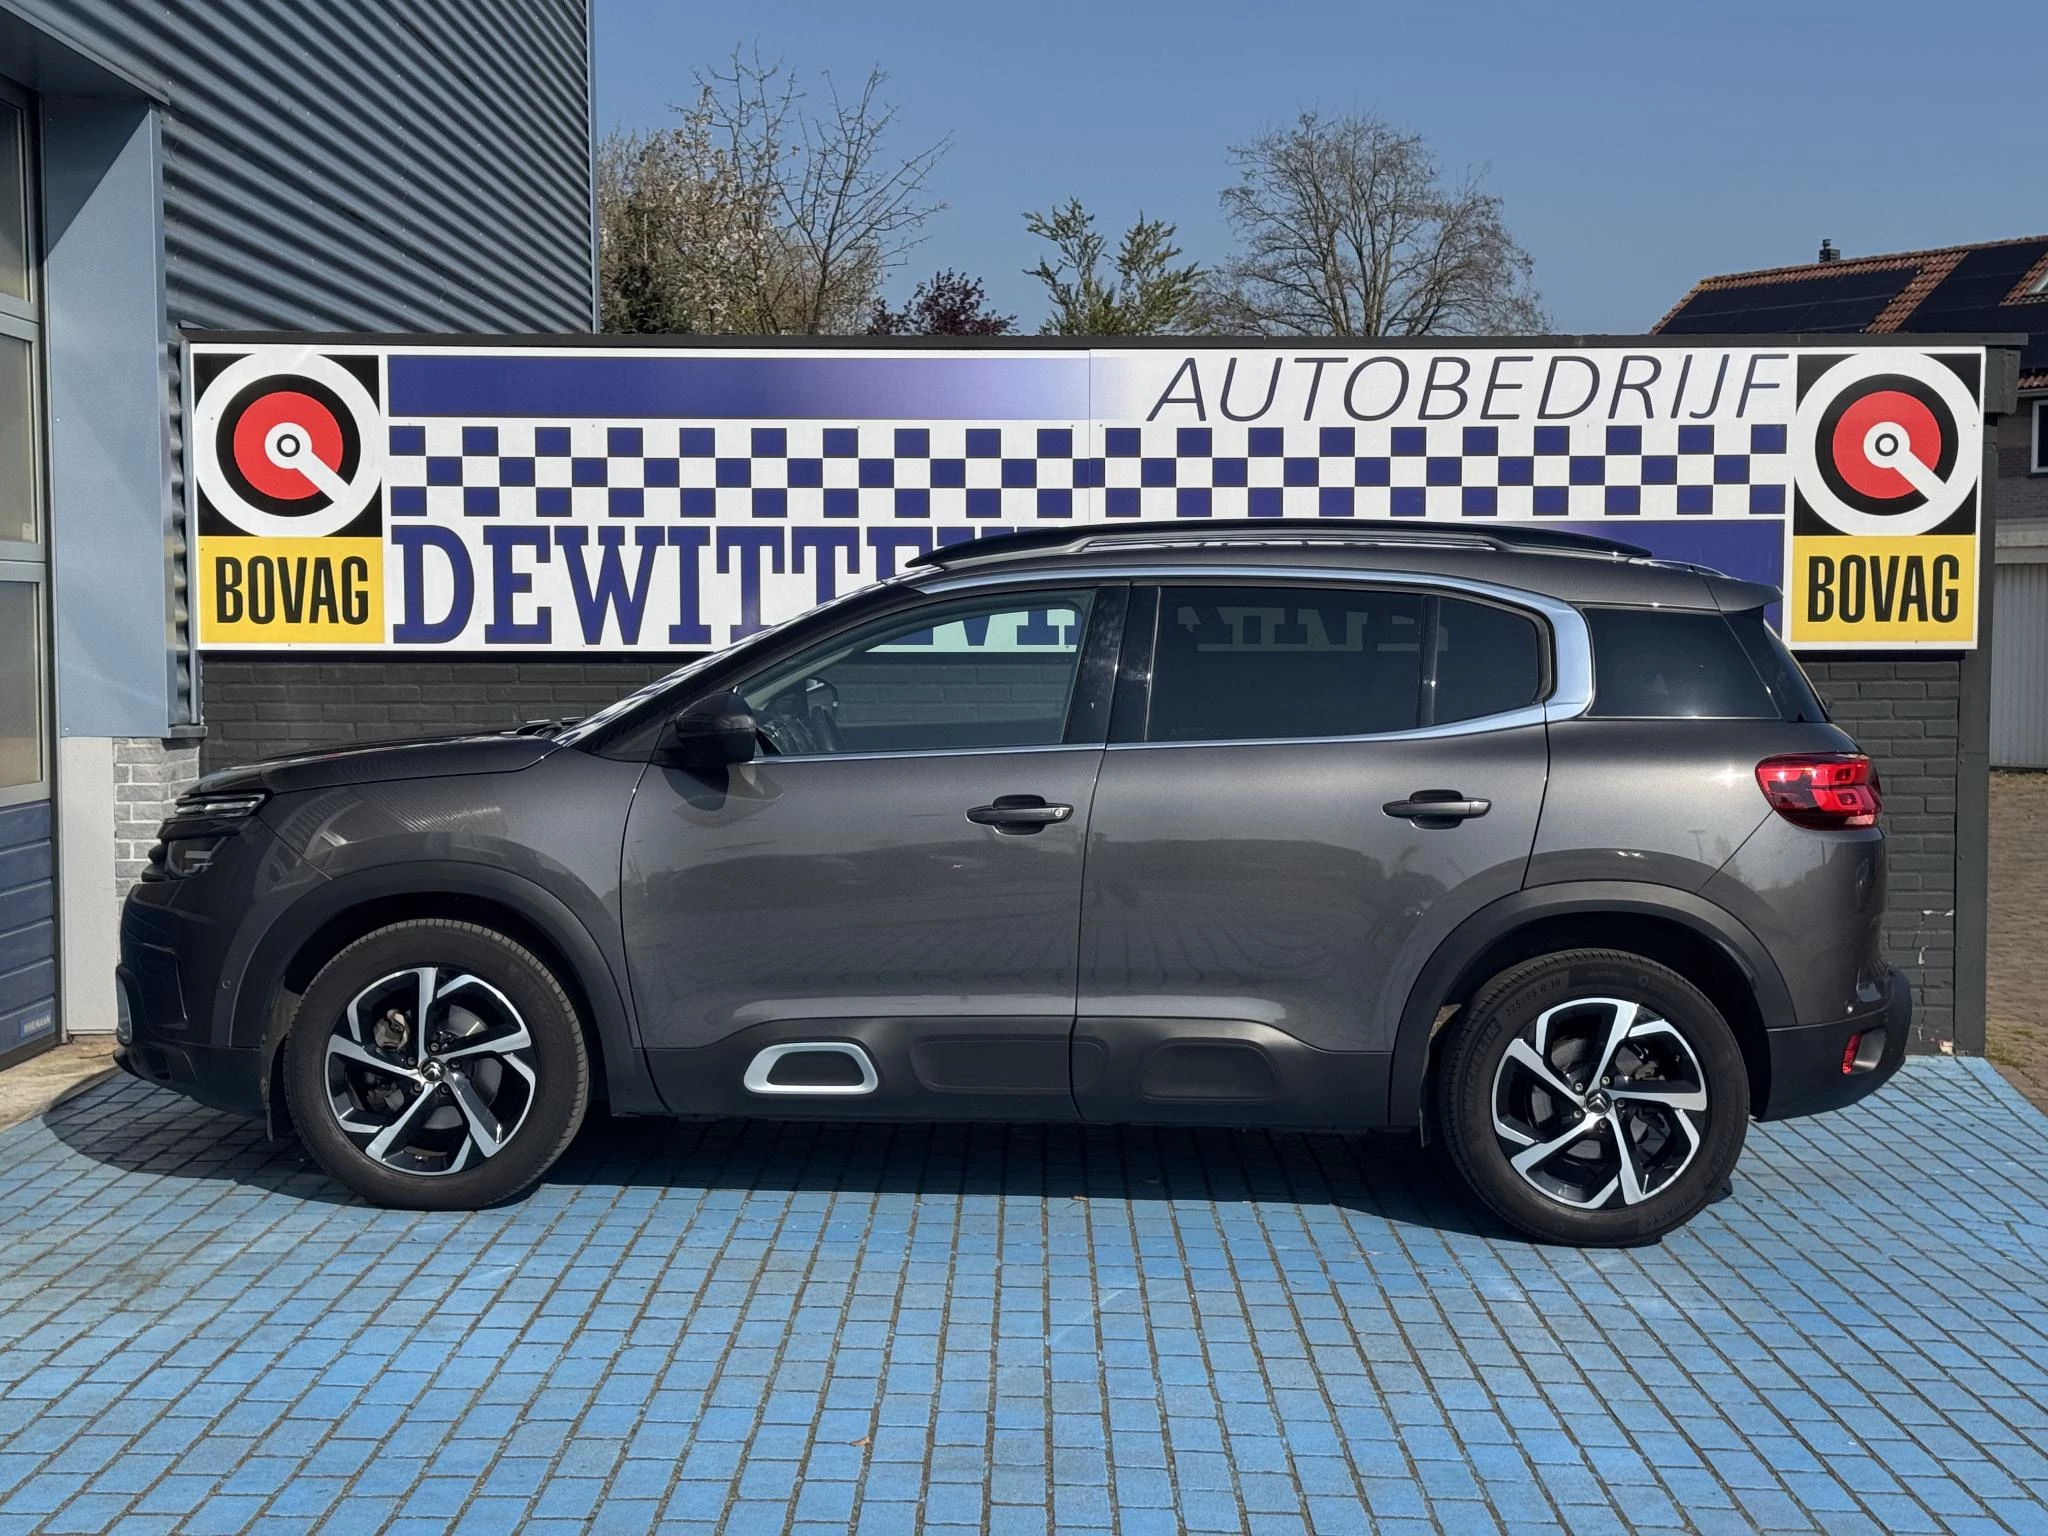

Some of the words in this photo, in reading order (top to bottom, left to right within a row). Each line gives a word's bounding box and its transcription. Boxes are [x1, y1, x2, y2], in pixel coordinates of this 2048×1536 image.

[1145, 353, 1790, 422] AUTOBEDRIJF
[215, 554, 369, 626] BOVAG
[1807, 553, 1960, 624] BOVAG
[1463, 1016, 1501, 1111] MICHELIN
